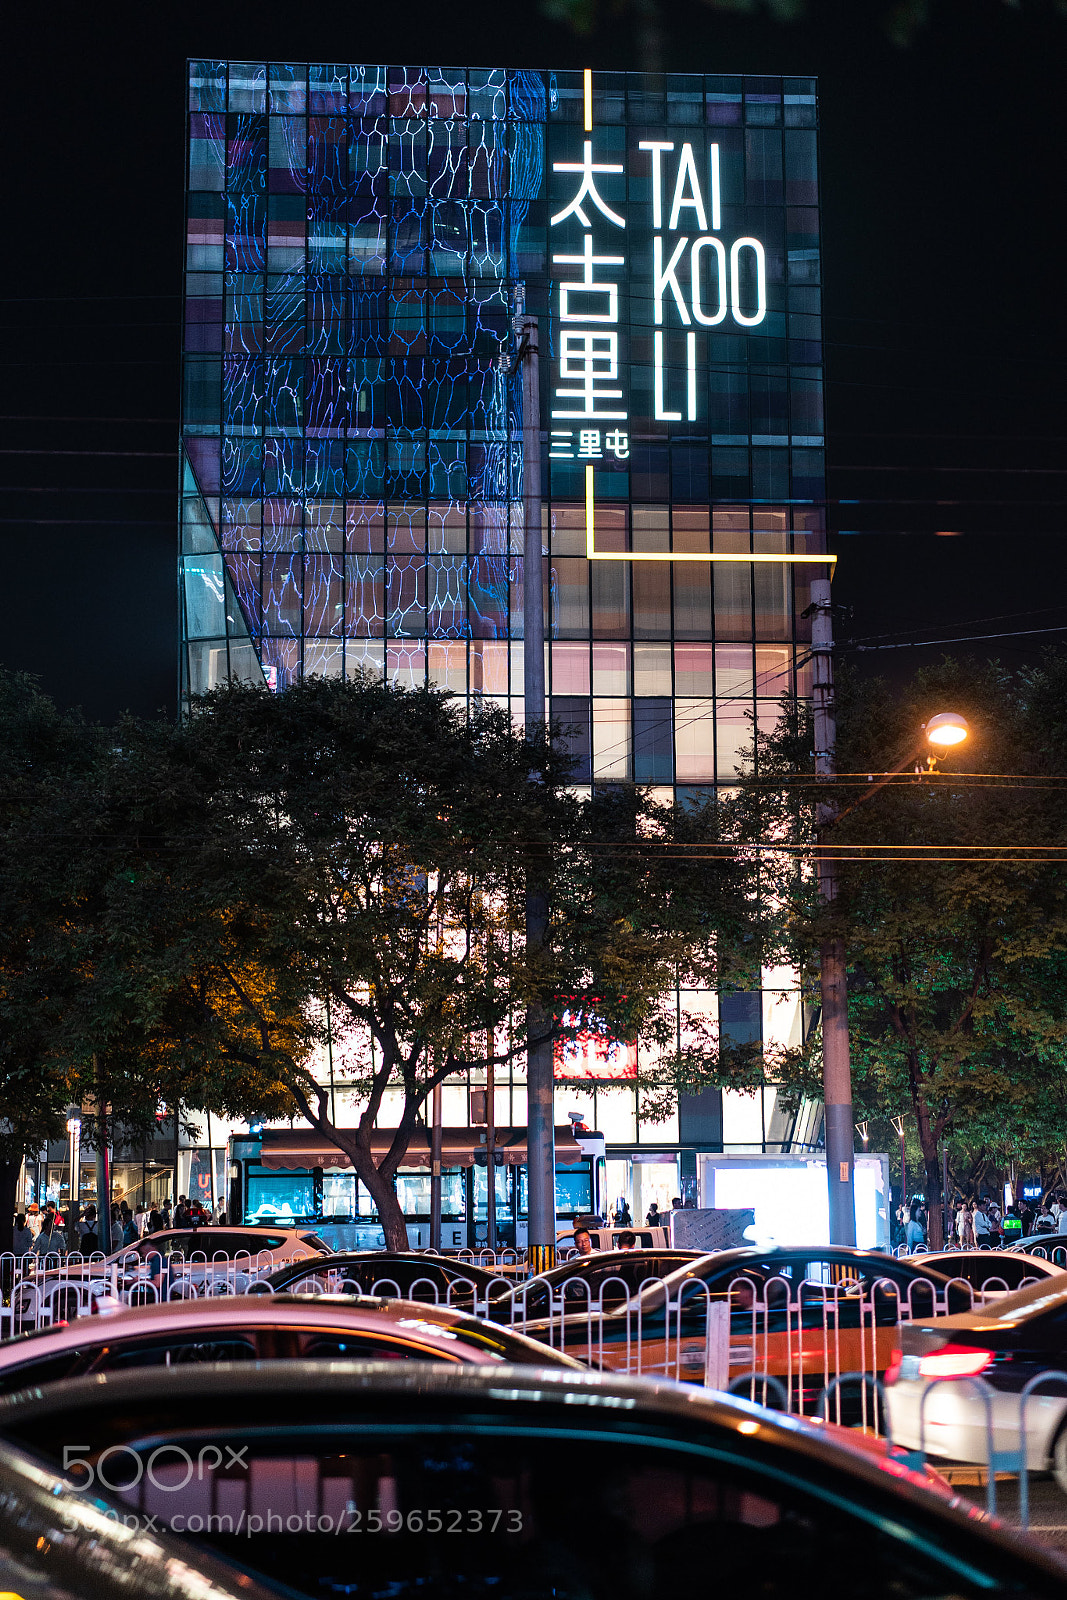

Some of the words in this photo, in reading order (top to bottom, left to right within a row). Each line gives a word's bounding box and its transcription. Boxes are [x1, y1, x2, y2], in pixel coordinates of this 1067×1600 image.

[638, 141, 721, 231] TAI
[551, 140, 628, 420] 太古里
[653, 235, 766, 327] KOO
[653, 331, 697, 422] LI
[548, 429, 630, 459] 三里屯
